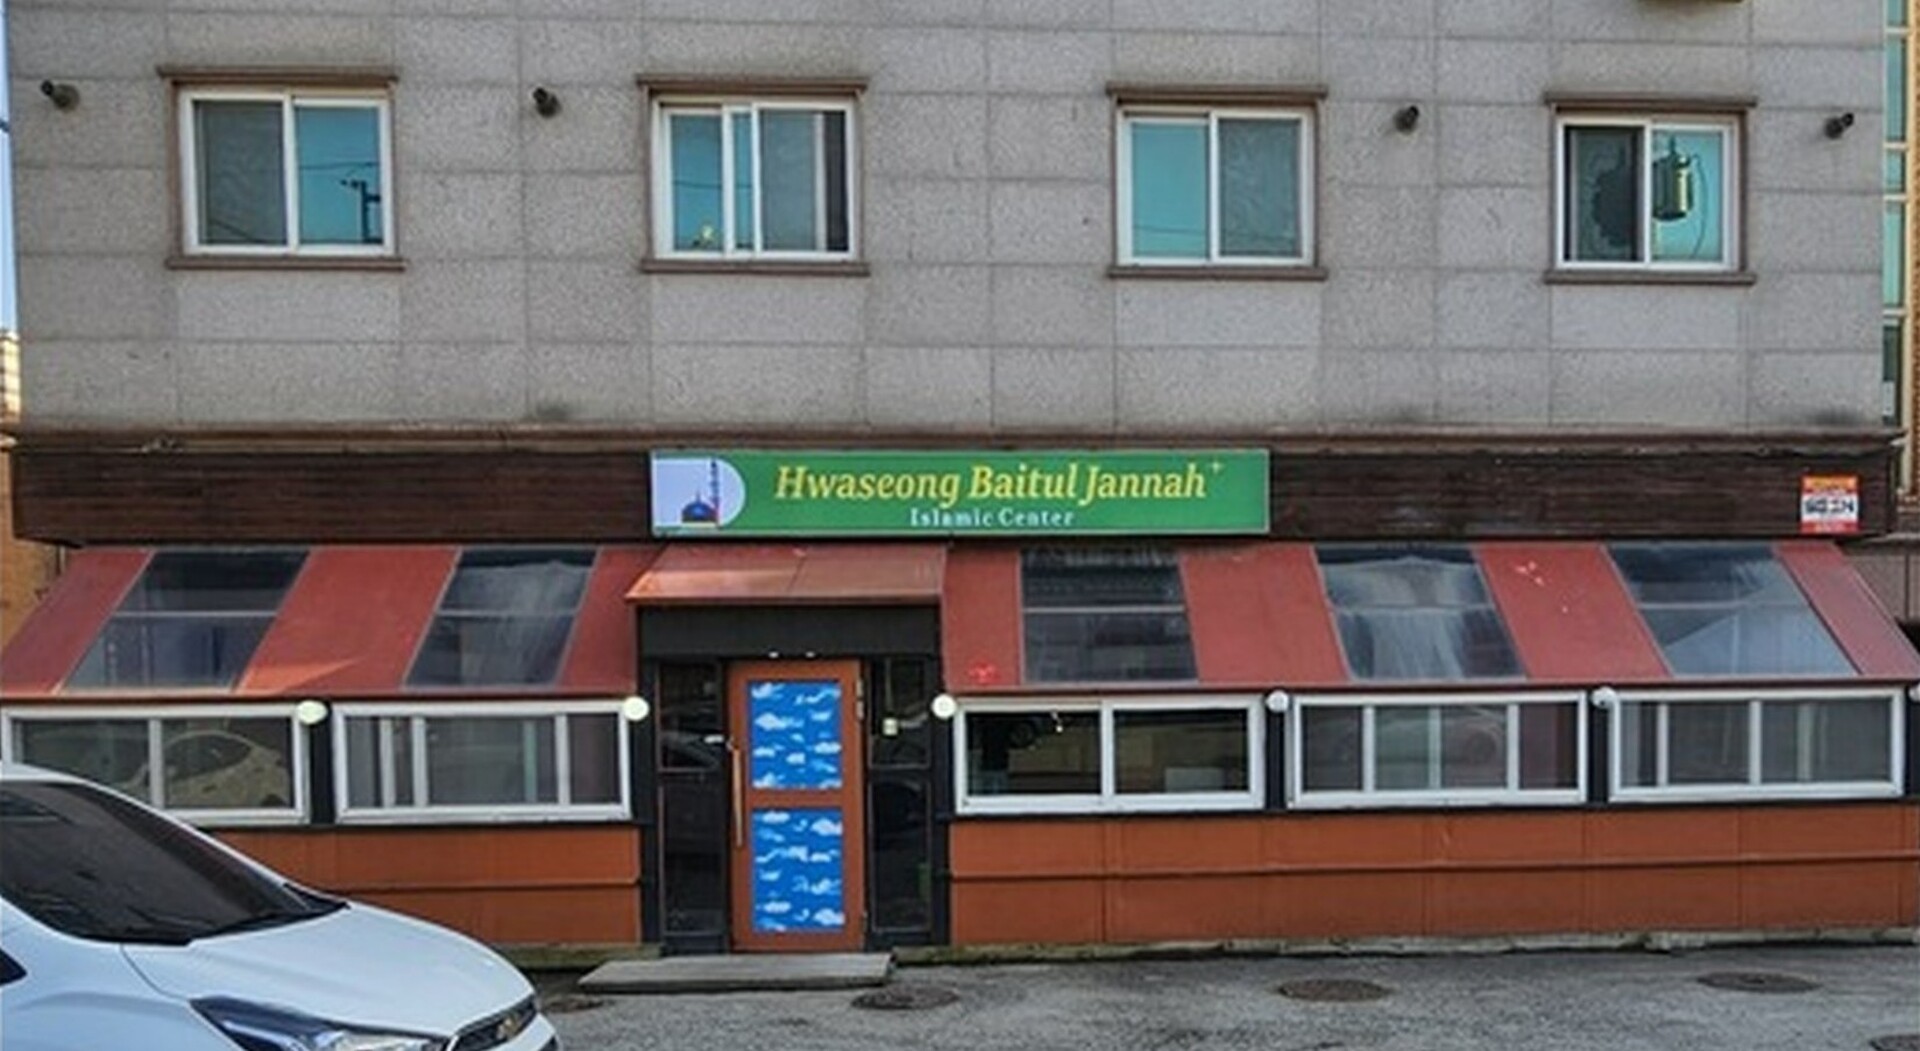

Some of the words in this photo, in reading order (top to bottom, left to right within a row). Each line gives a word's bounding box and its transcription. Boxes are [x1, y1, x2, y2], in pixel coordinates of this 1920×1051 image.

[775, 465, 961, 509] Hwaseong
[968, 463, 1078, 499] Baitul
[1077, 463, 1207, 506] Jannah
[910, 507, 994, 527] Islamic
[999, 507, 1076, 527] Center
